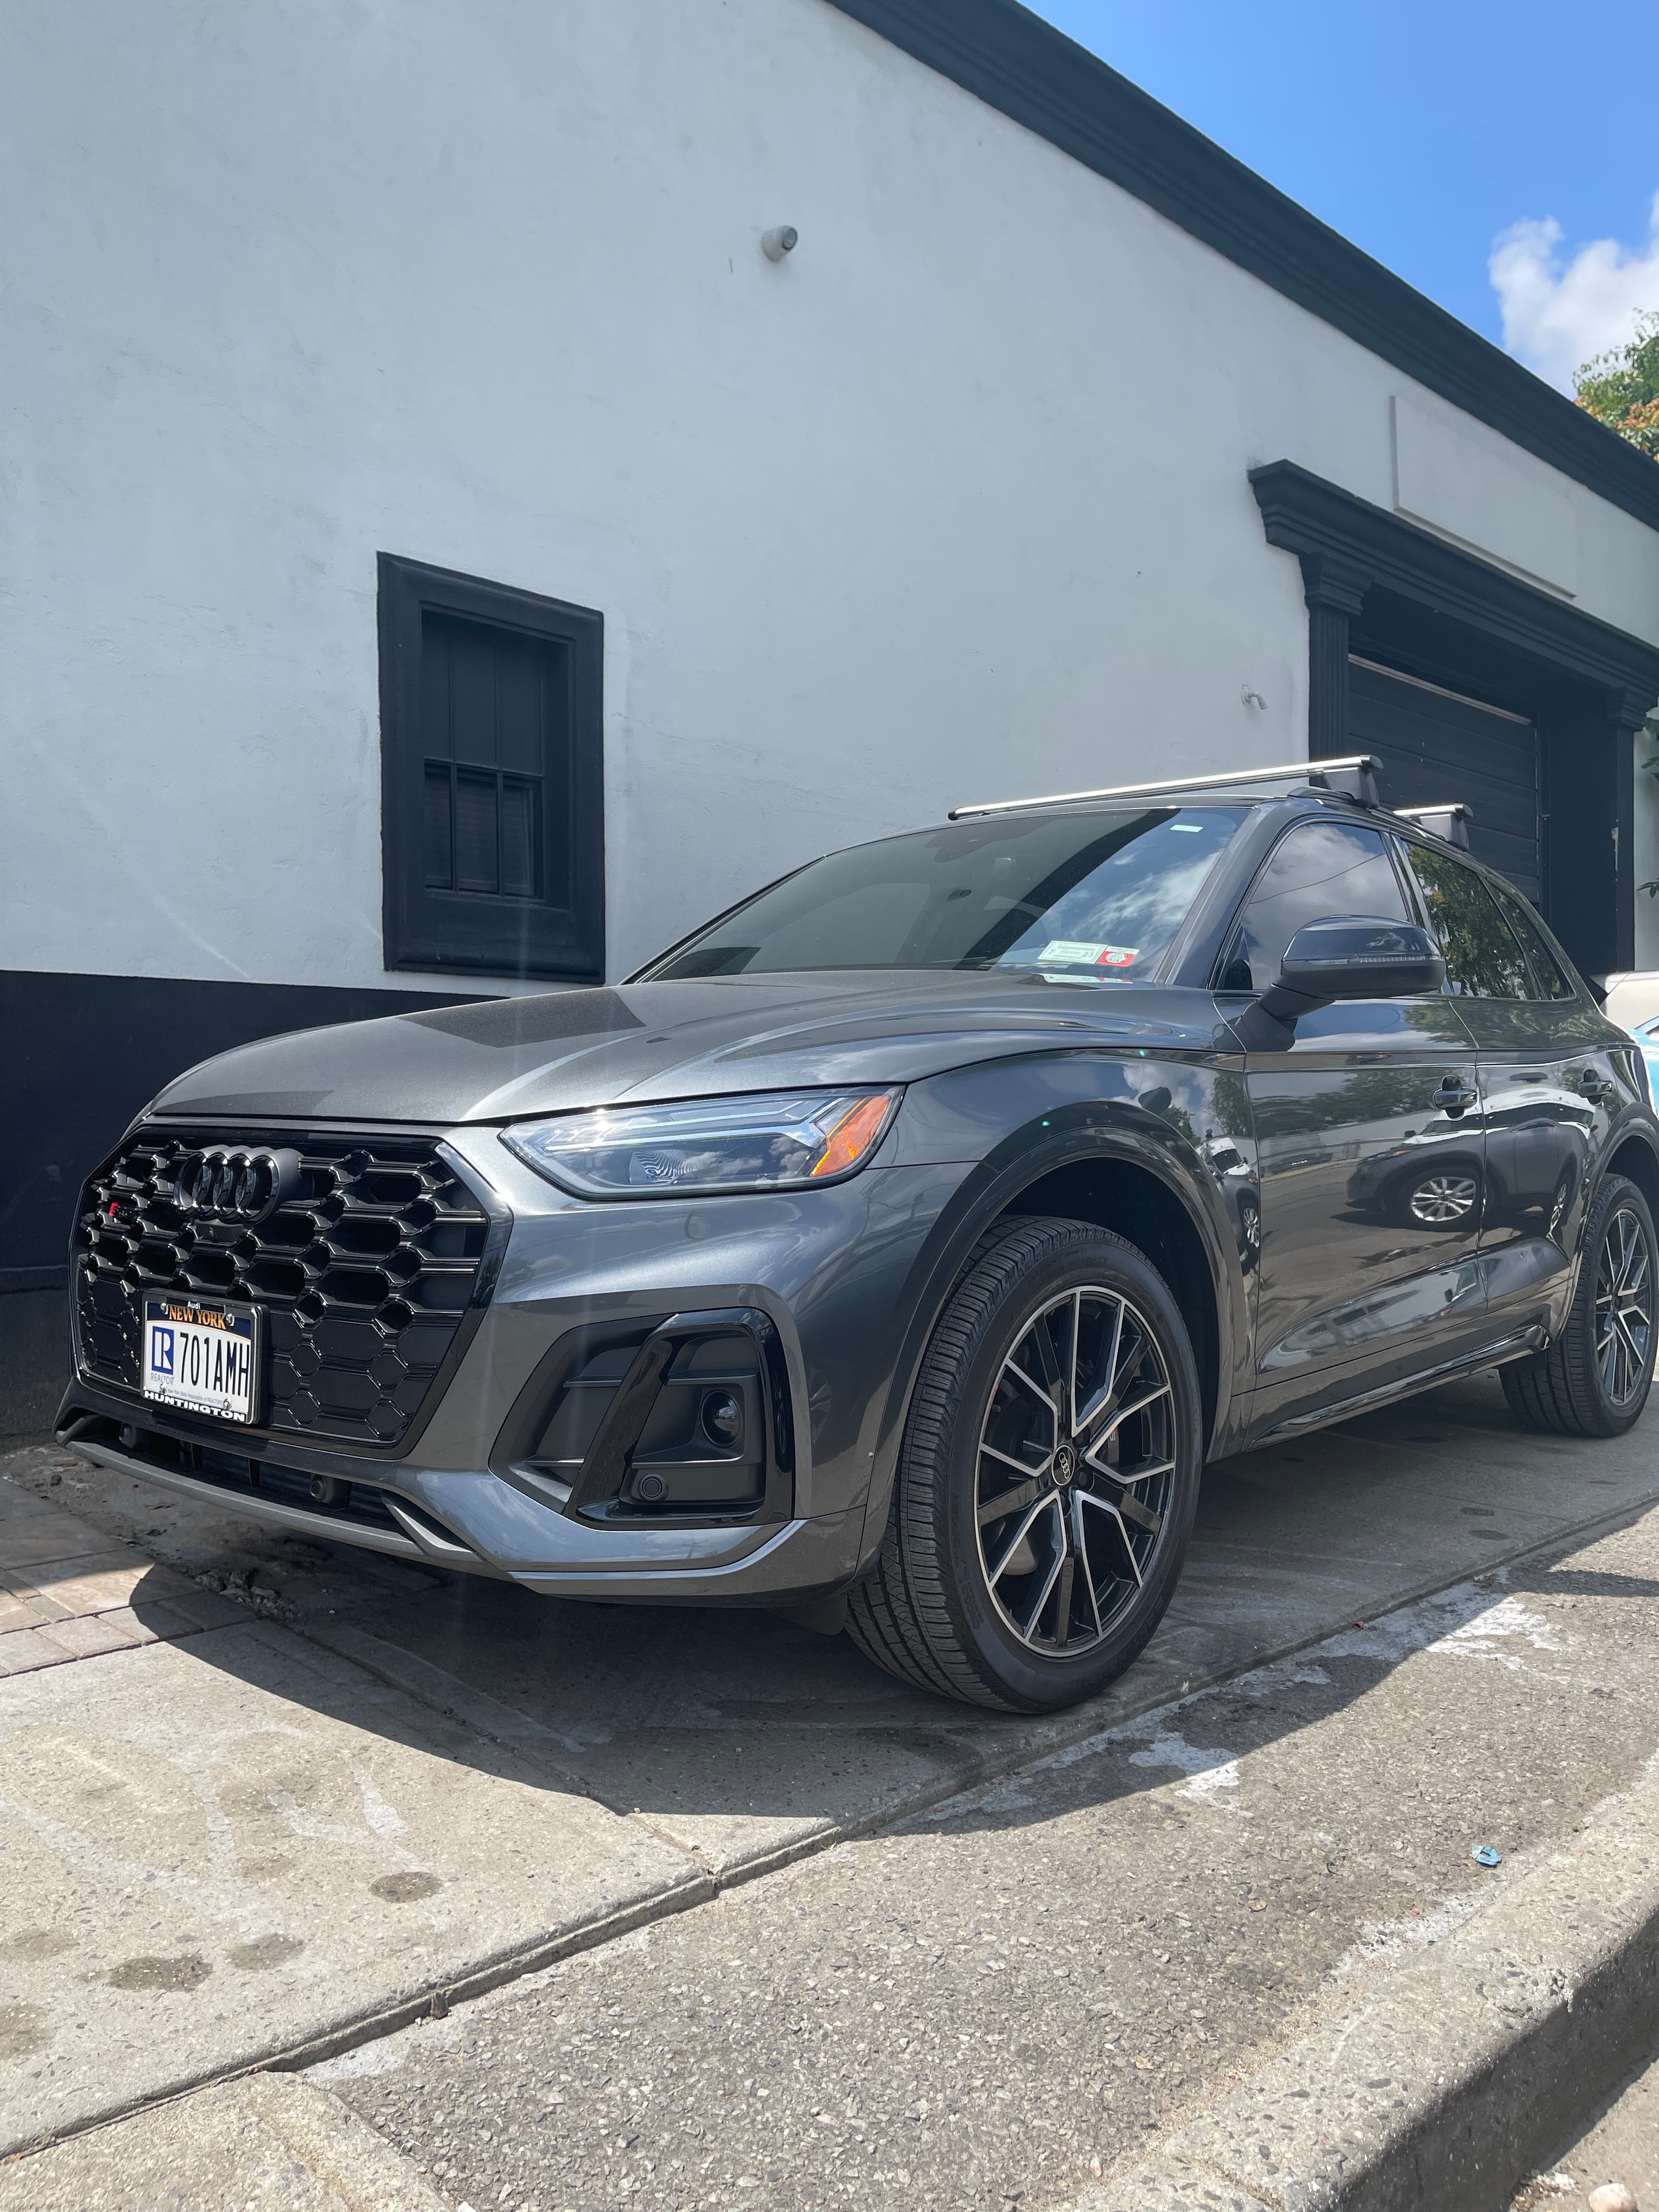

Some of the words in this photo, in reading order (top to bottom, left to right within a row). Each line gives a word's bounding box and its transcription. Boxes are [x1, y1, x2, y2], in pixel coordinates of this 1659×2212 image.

[169, 1305, 194, 1322] NEW
[196, 1309, 226, 1330] YORK
[187, 1301, 200, 1309] Audi
[180, 1332, 250, 1398] 701AMH
[151, 1372, 174, 1385] REALTOR
[144, 1389, 245, 1422] HUNTINGTON
